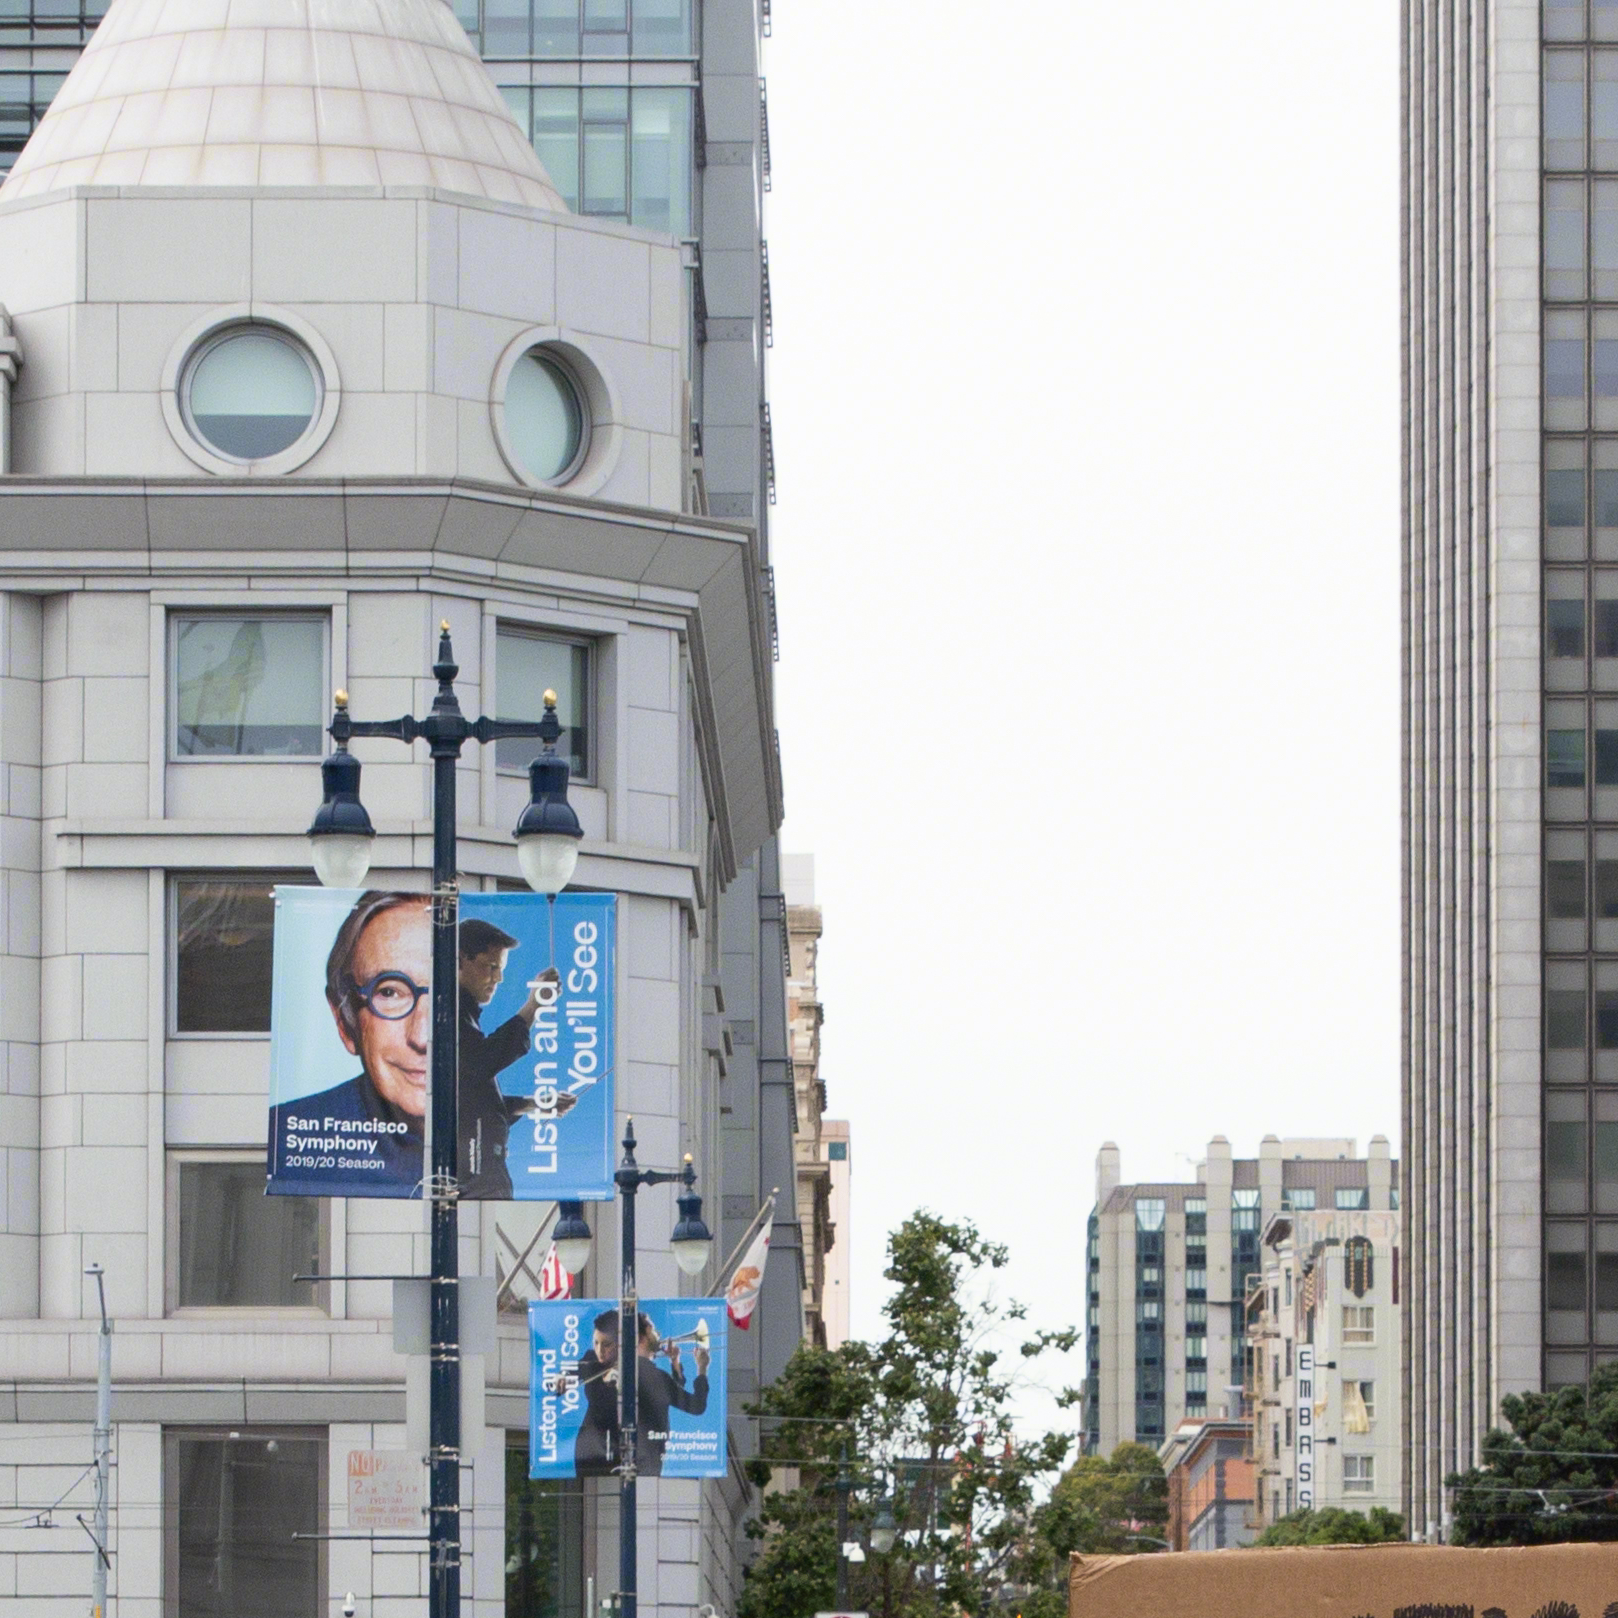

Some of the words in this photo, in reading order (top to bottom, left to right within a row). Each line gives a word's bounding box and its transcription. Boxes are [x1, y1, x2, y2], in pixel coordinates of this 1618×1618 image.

[567, 920, 598, 994] See
[527, 980, 558, 1055] and
[565, 1000, 598, 1095] You'll
[286, 1116, 321, 1132] San
[323, 1117, 409, 1134] Francisco
[527, 1062, 558, 1174] Listen
[285, 1134, 378, 1155] Symphony
[285, 1155, 336, 1170] 2019/20
[337, 1156, 386, 1170] Season
[563, 1314, 580, 1358] See
[539, 1348, 557, 1392] and
[539, 1395, 558, 1463] Listen
[647, 1430, 668, 1441] San
[669, 1430, 718, 1441] Francisco
[664, 1441, 718, 1452] Symphony
[1299, 1351, 1312, 1509] EMBASS
[690, 1454, 718, 1462] Season
